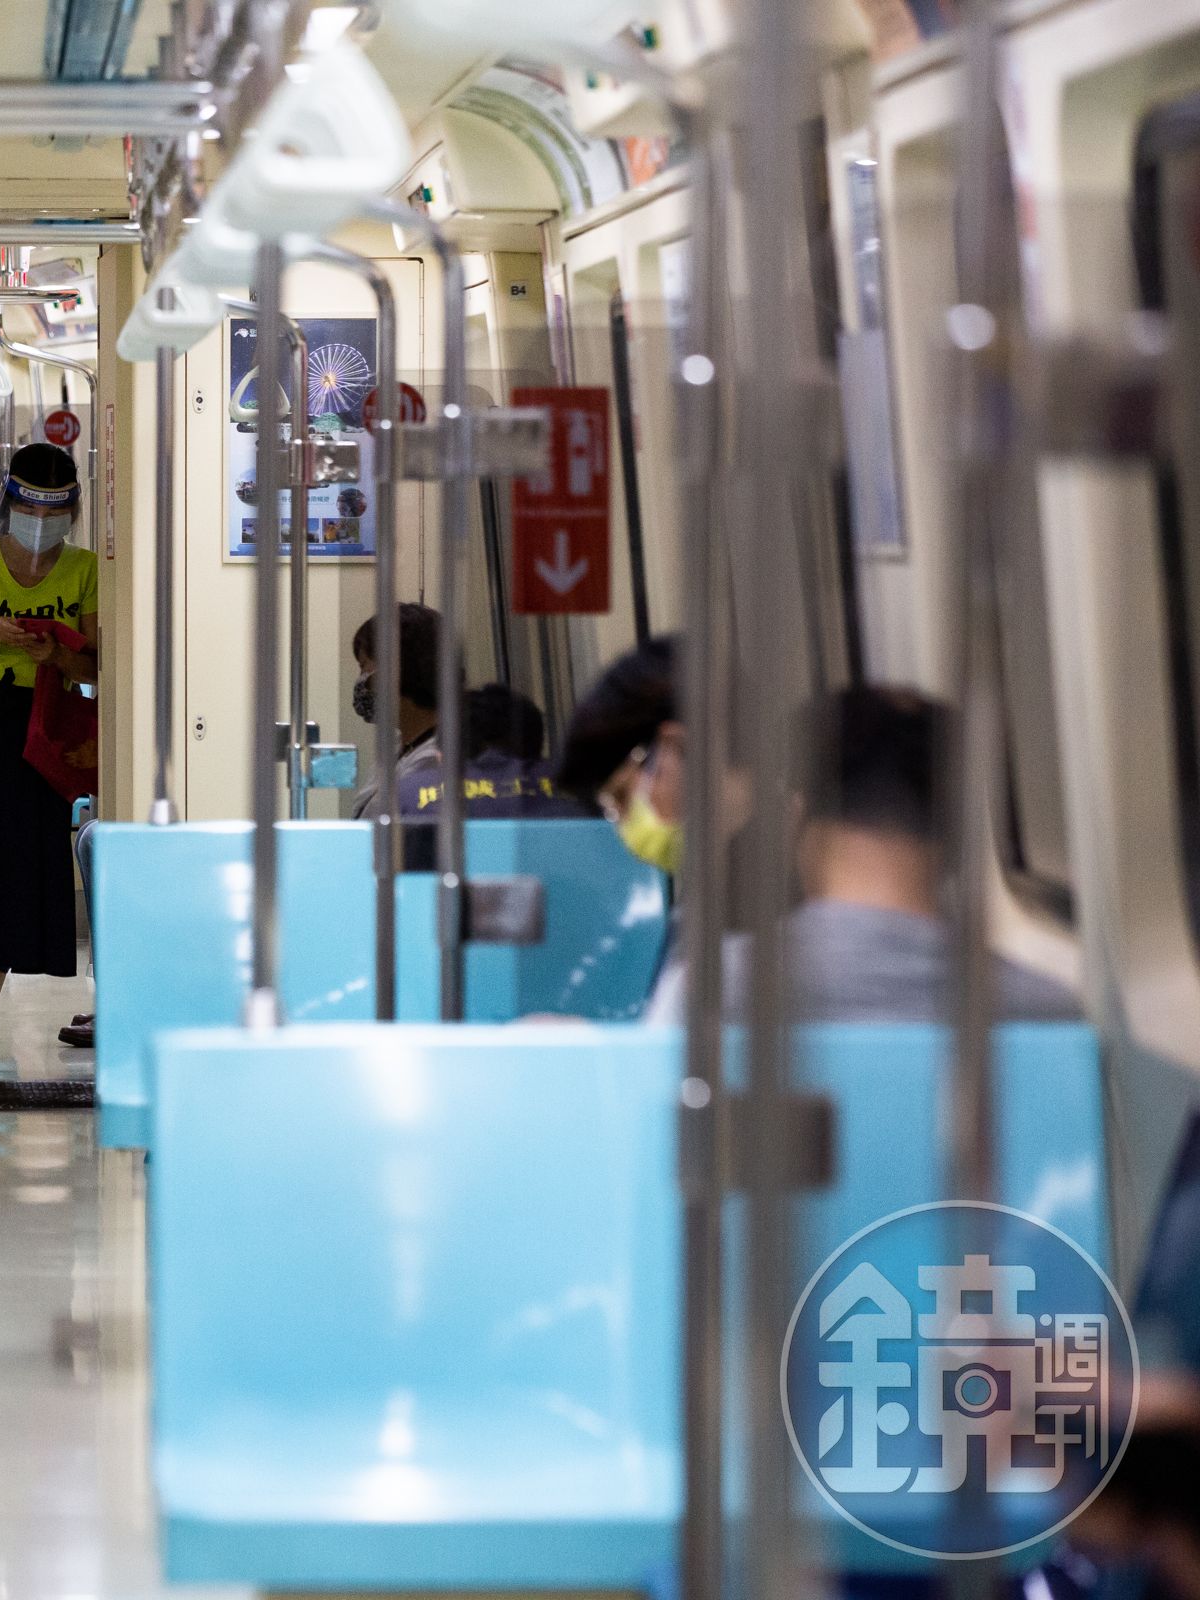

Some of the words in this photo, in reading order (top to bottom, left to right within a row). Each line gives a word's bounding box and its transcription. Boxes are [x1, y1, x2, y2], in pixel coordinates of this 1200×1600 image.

[511, 285, 526, 296] B4
[22, 488, 40, 499] Face
[43, 492, 67, 501] Shield
